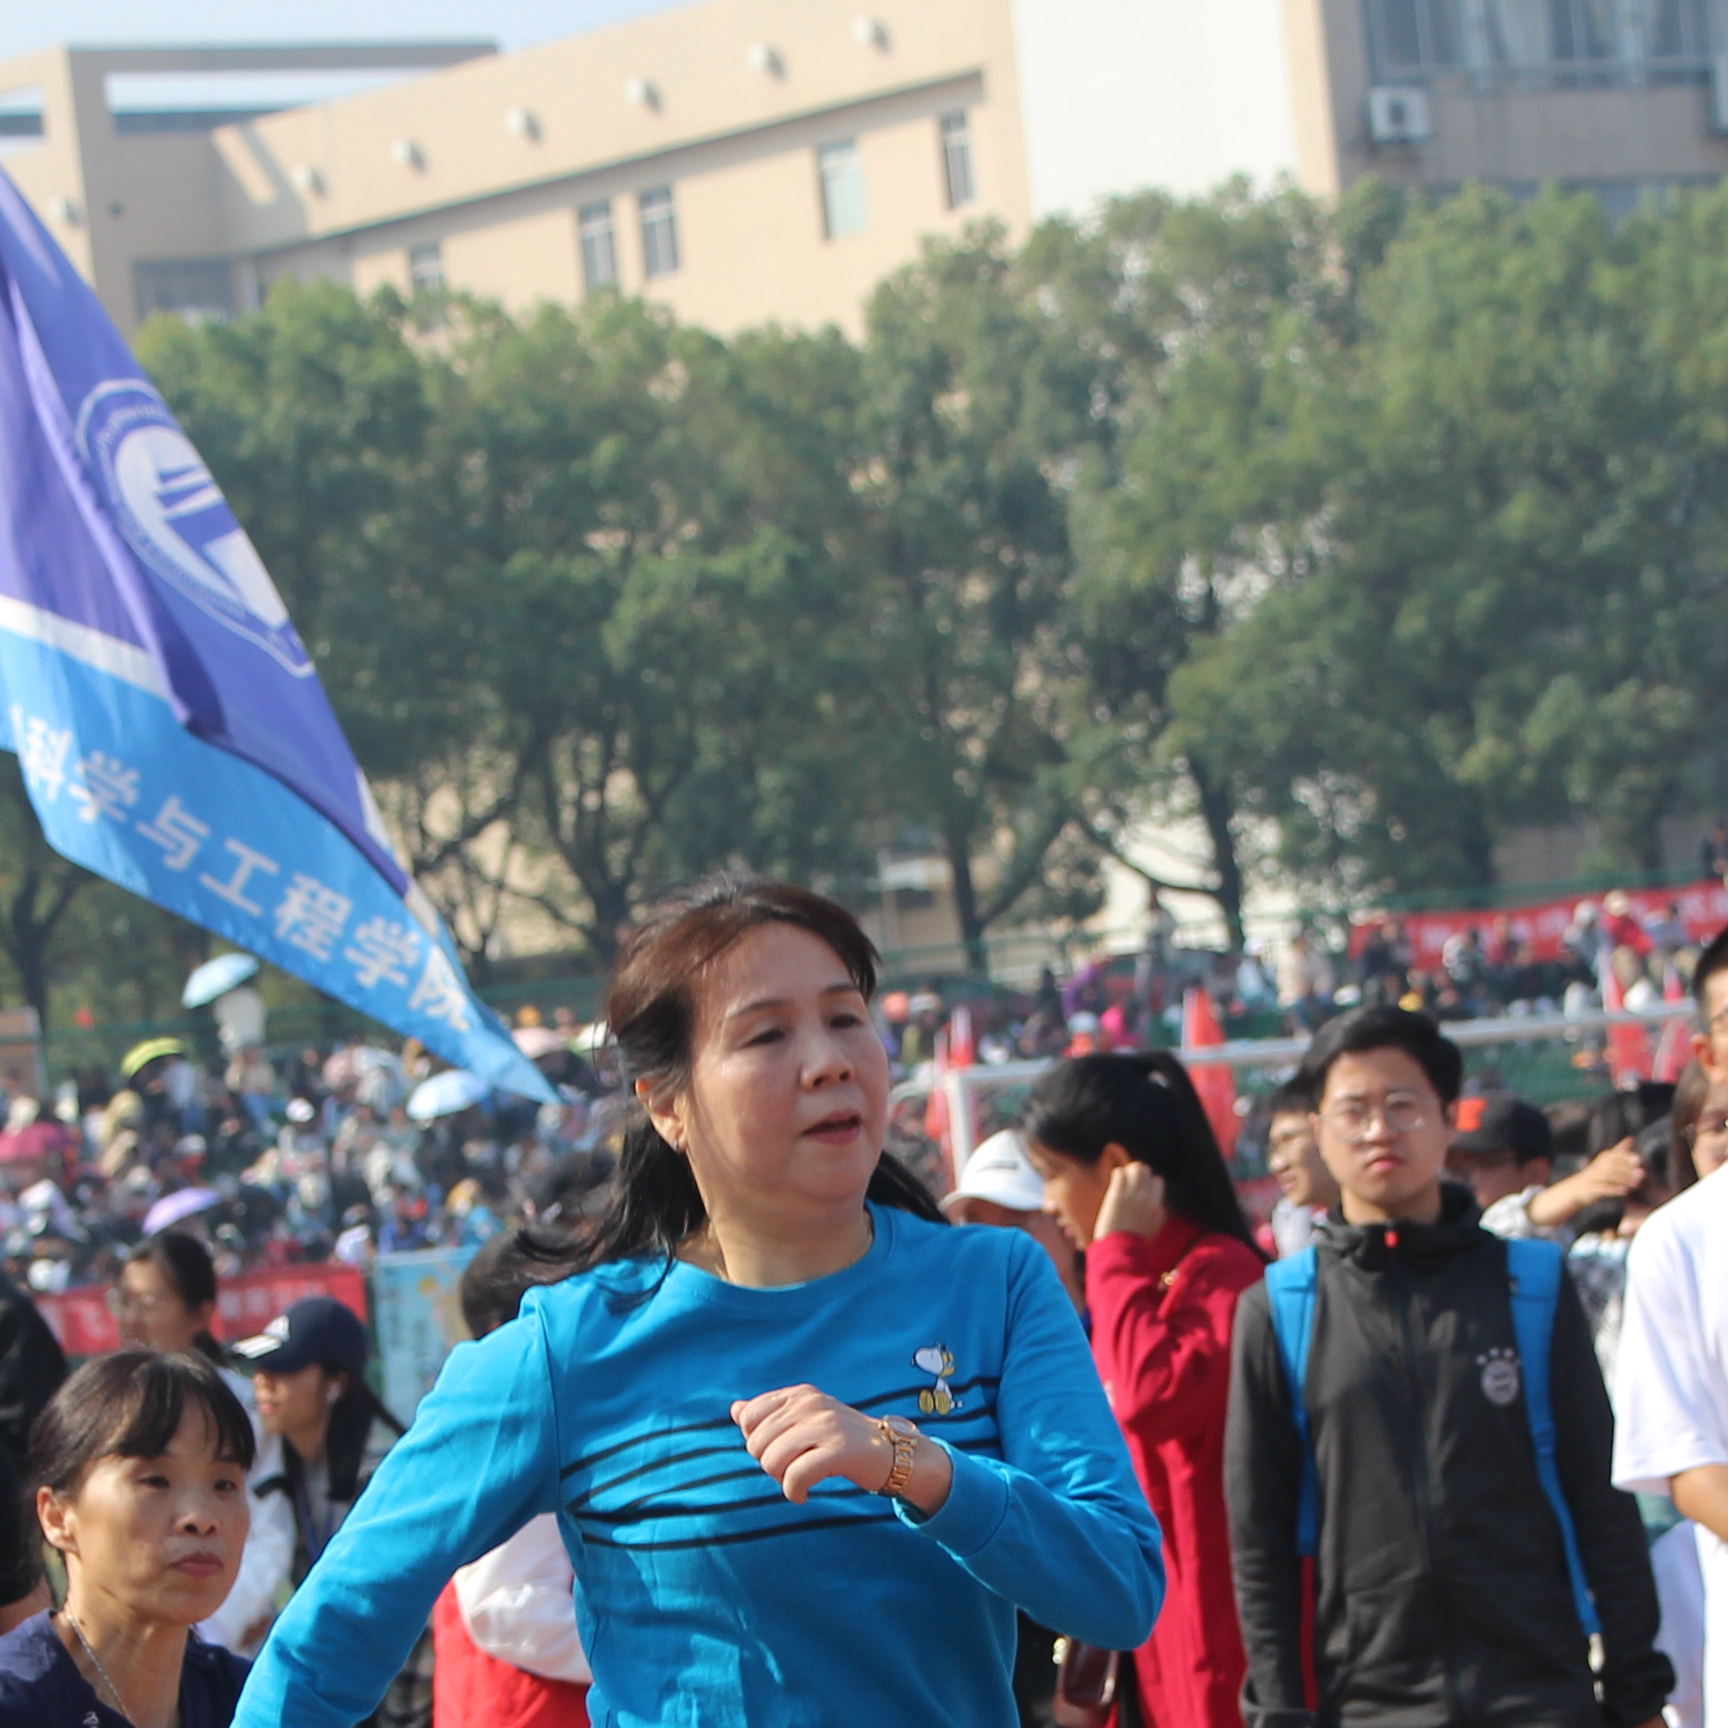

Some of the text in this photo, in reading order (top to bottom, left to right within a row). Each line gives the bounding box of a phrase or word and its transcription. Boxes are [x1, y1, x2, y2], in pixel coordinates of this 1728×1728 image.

[10, 704, 472, 1032] 科学与工程学院
